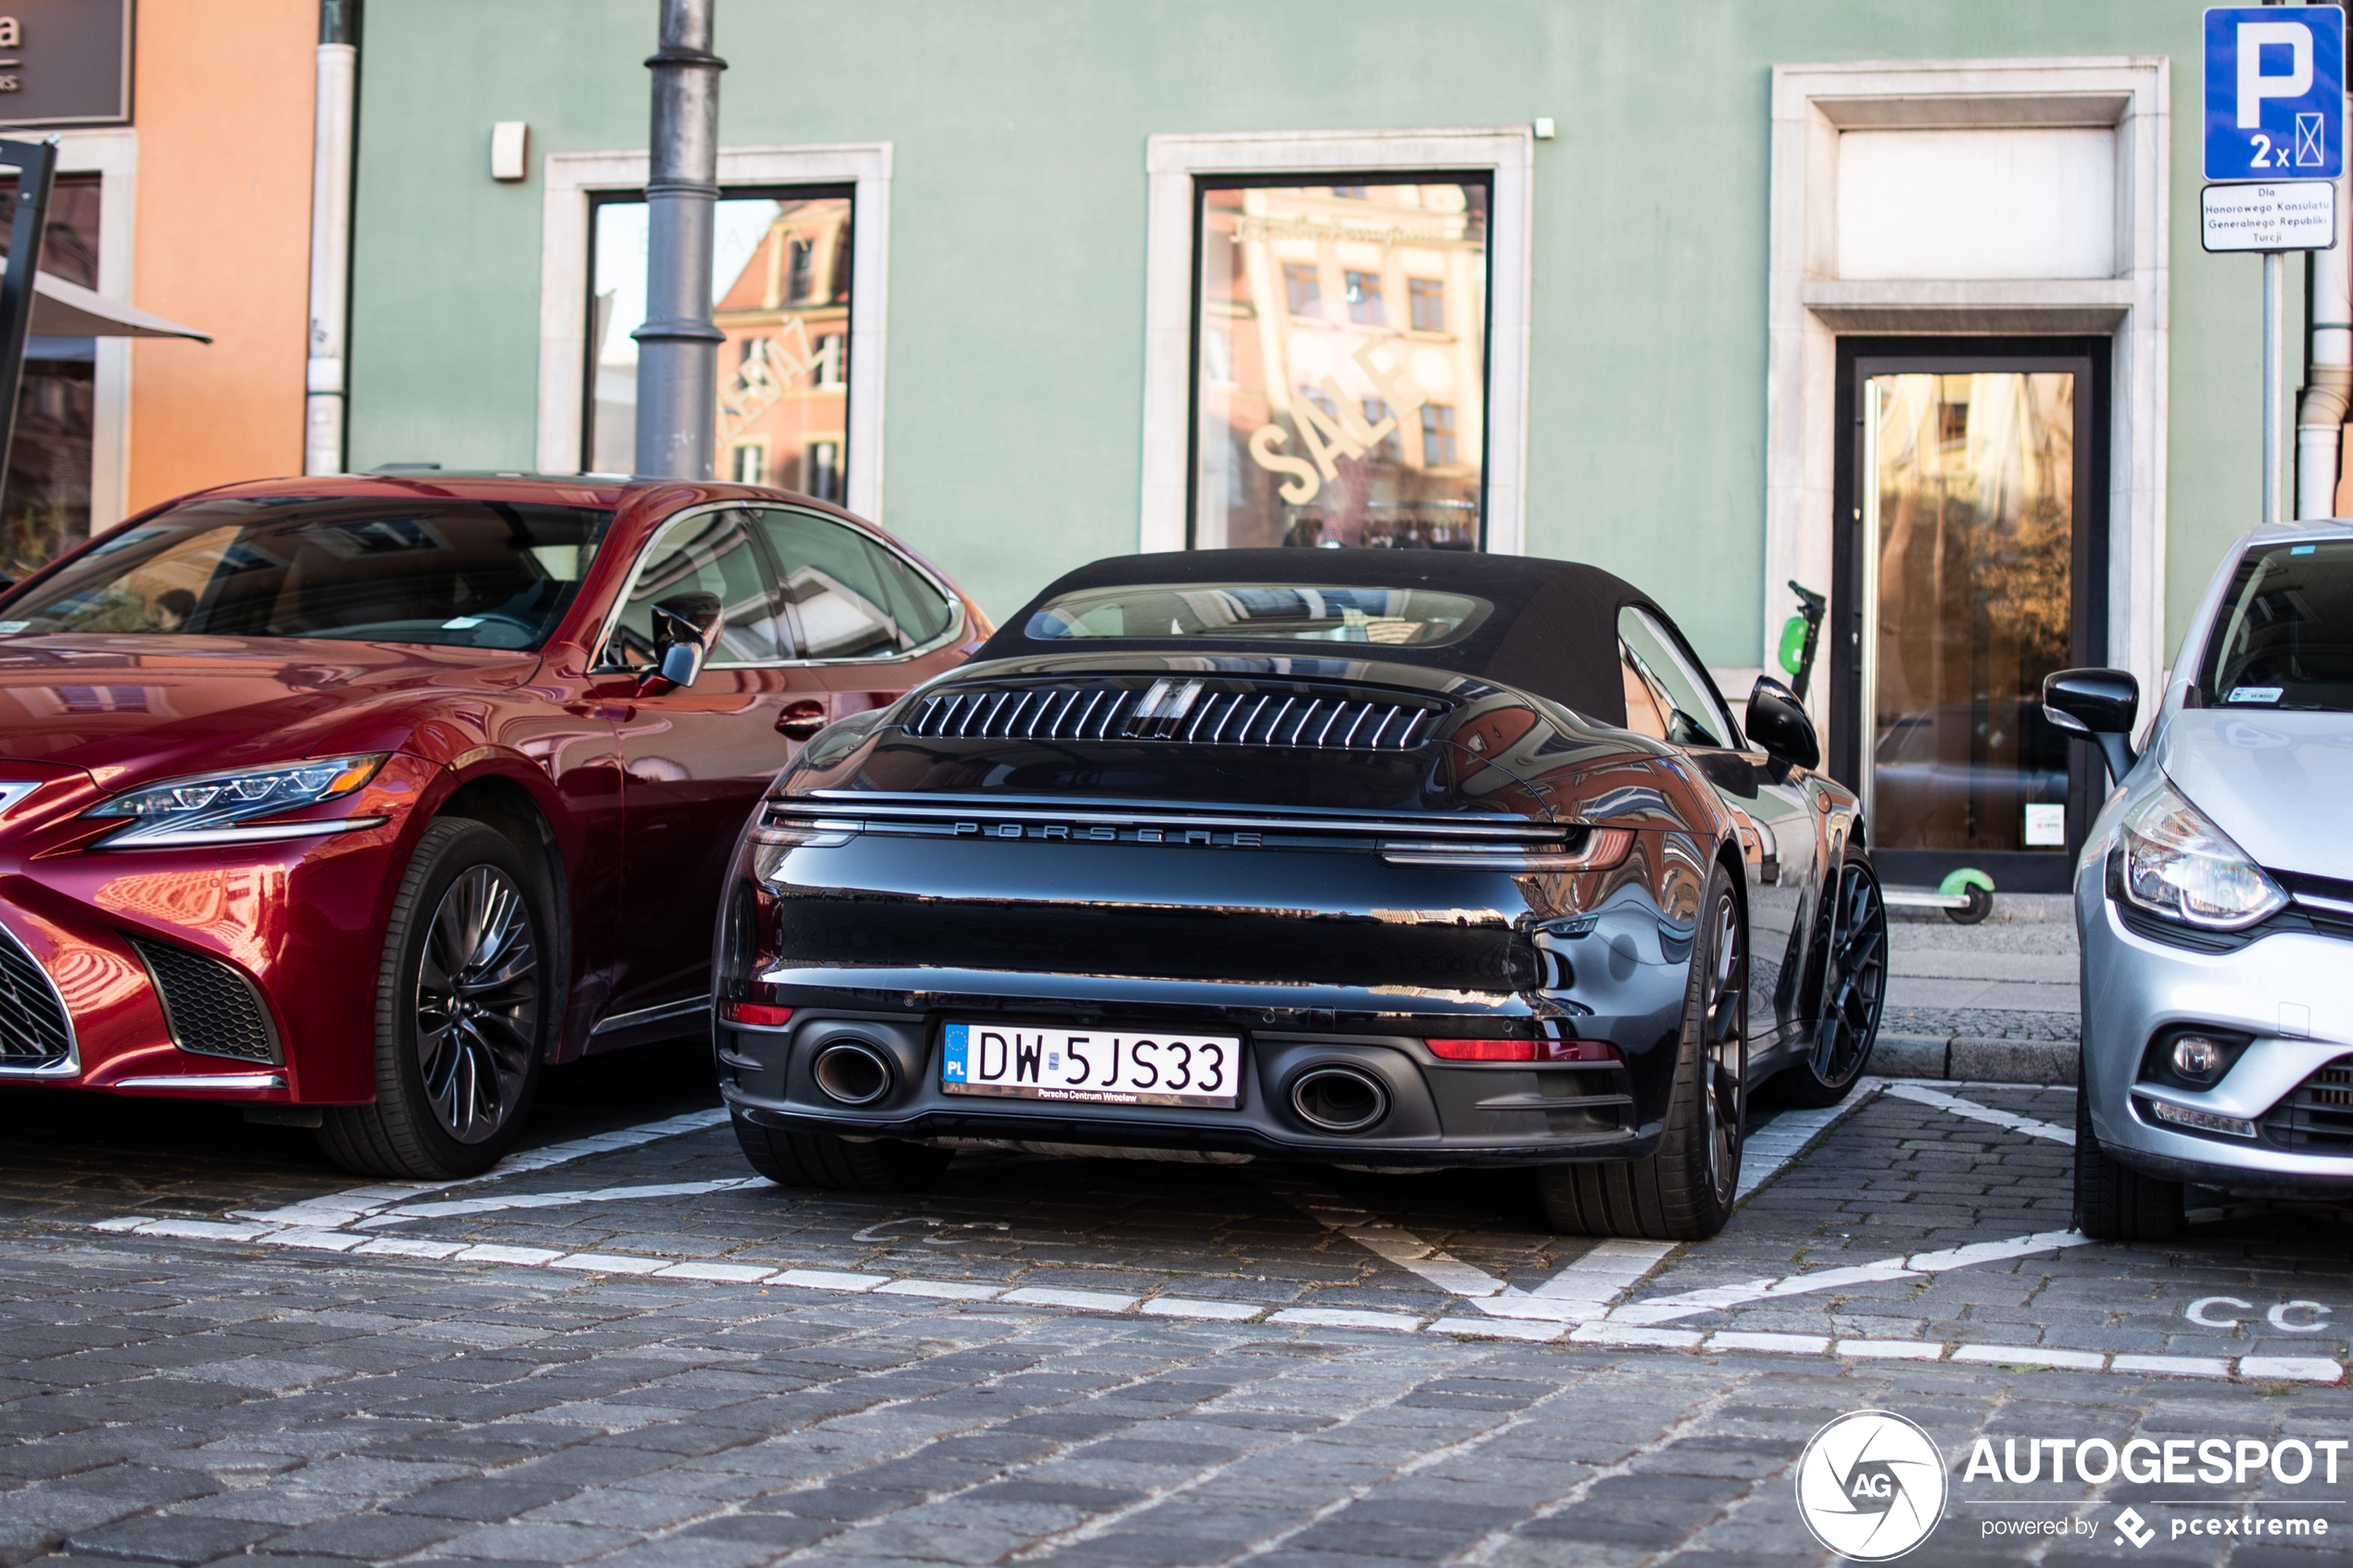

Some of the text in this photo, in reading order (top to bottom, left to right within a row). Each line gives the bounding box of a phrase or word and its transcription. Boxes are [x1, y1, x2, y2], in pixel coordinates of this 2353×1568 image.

[2237, 21, 2314, 129] P
[2250, 133, 2271, 168] 2
[2259, 188, 2275, 196] Dla
[2206, 201, 2330, 214] Honorowego Konsulatu
[2208, 216, 2327, 229] Generalnego Republiki
[2253, 232, 2282, 244] Turcji
[1249, 334, 1430, 506] SALE
[954, 822, 1263, 847] PORSCHE
[948, 1032, 1224, 1093] PL DW 5JS33
[1038, 1088, 1069, 1099] Porsche
[1069, 1090, 1102, 1101] Centrum
